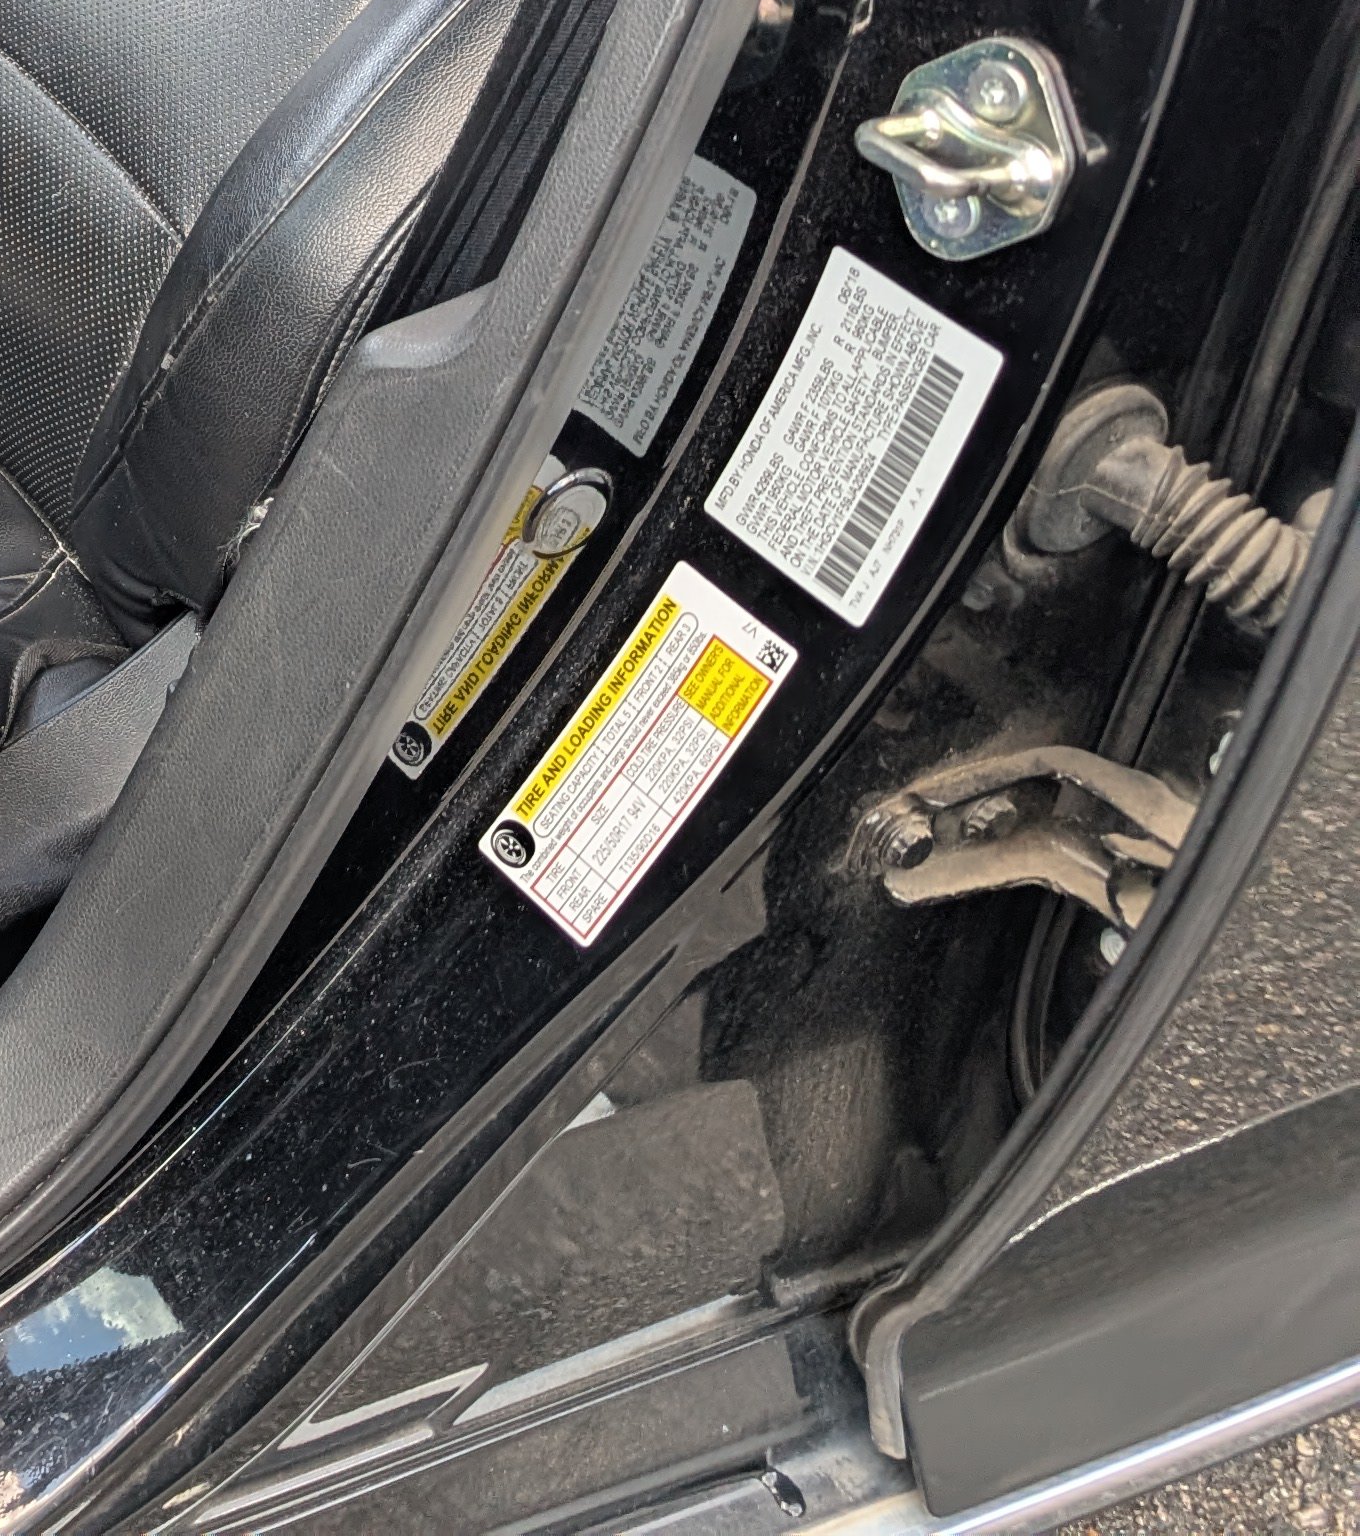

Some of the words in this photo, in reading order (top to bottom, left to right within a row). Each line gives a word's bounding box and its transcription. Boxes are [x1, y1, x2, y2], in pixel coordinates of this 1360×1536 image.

[837, 284, 870, 333] 2116LBS
[887, 305, 920, 353] EFFECT
[832, 334, 845, 347] R
[843, 341, 856, 354] R
[847, 305, 890, 374] APPLICABLE
[921, 321, 942, 348] CAR
[882, 350, 898, 367] IN
[804, 356, 835, 404] 2359LBS
[815, 368, 844, 412] 1070KG
[831, 390, 847, 410] TO
[839, 370, 857, 394] ALL
[850, 364, 891, 432] STANDARDS
[737, 429, 765, 473] HONDA
[757, 414, 774, 436] OF
[766, 367, 799, 420] AMERICA
[781, 409, 806, 446] GAWR
[799, 401, 811, 413] F
[810, 409, 822, 421] F
[792, 417, 817, 454] GAWR
[797, 406, 838, 473] CONFORMS
[767, 498, 803, 553] FEDERAL
[796, 459, 825, 504] MOTOR
[818, 413, 850, 464] VEHICLE
[788, 547, 806, 569] ON
[799, 524, 819, 552] THE
[812, 495, 837, 529] DATE
[829, 479, 846, 499] OF
[839, 398, 889, 483] MANUFACTURE
[881, 356, 911, 402] SHOWN
[812, 429, 857, 503] PREVENTION
[734, 491, 759, 528] GVWR
[751, 449, 784, 499] 4299LBS
[745, 499, 770, 537] GVWR
[764, 462, 793, 506] 1950KG
[772, 468, 805, 520] VEHICLE
[756, 513, 778, 544] THIS
[792, 496, 819, 537] THEFT
[778, 532, 799, 560] AND
[664, 629, 687, 657] REAR
[681, 622, 691, 632] 3
[632, 671, 658, 703] FRONT
[652, 663, 663, 674] 2
[682, 680, 700, 700] SEE
[692, 642, 725, 684] OWNER'S
[694, 674, 723, 710] MANUAL
[716, 656, 735, 678] FOR
[515, 781, 546, 819] TIRE
[539, 751, 568, 787] AND
[562, 690, 613, 757] LOADING
[605, 596, 679, 695] INFORMATION
[707, 671, 746, 721] ADDITIONAL
[720, 674, 765, 732] INFORMATION
[601, 716, 626, 746] TOTAL
[621, 708, 631, 718] 5
[625, 754, 645, 778] COLD
[640, 737, 658, 757] TIRE
[652, 697, 686, 741] PRESSURE
[670, 715, 694, 745] 32PSI
[684, 727, 708, 756] 32PSI
[519, 866, 535, 884] The
[530, 836, 558, 872] combined
[553, 816, 575, 842] weight
[568, 808, 580, 820] of
[574, 777, 604, 814] occupants
[598, 764, 613, 781] and
[609, 746, 628, 769] cargo
[621, 724, 642, 749] should
[638, 706, 655, 727] never
[650, 681, 672, 708] exceed
[682, 653, 692, 664] or
[539, 790, 571, 831] SEATING
[565, 749, 601, 795] CAPACITY
[590, 802, 609, 826] SIZE
[591, 814, 633, 867] 225/50R17
[626, 795, 647, 820] 94V
[545, 860, 565, 884] TIRE
[555, 866, 582, 901] FRONT
[568, 884, 591, 912] REAR
[581, 891, 608, 925] SPARE
